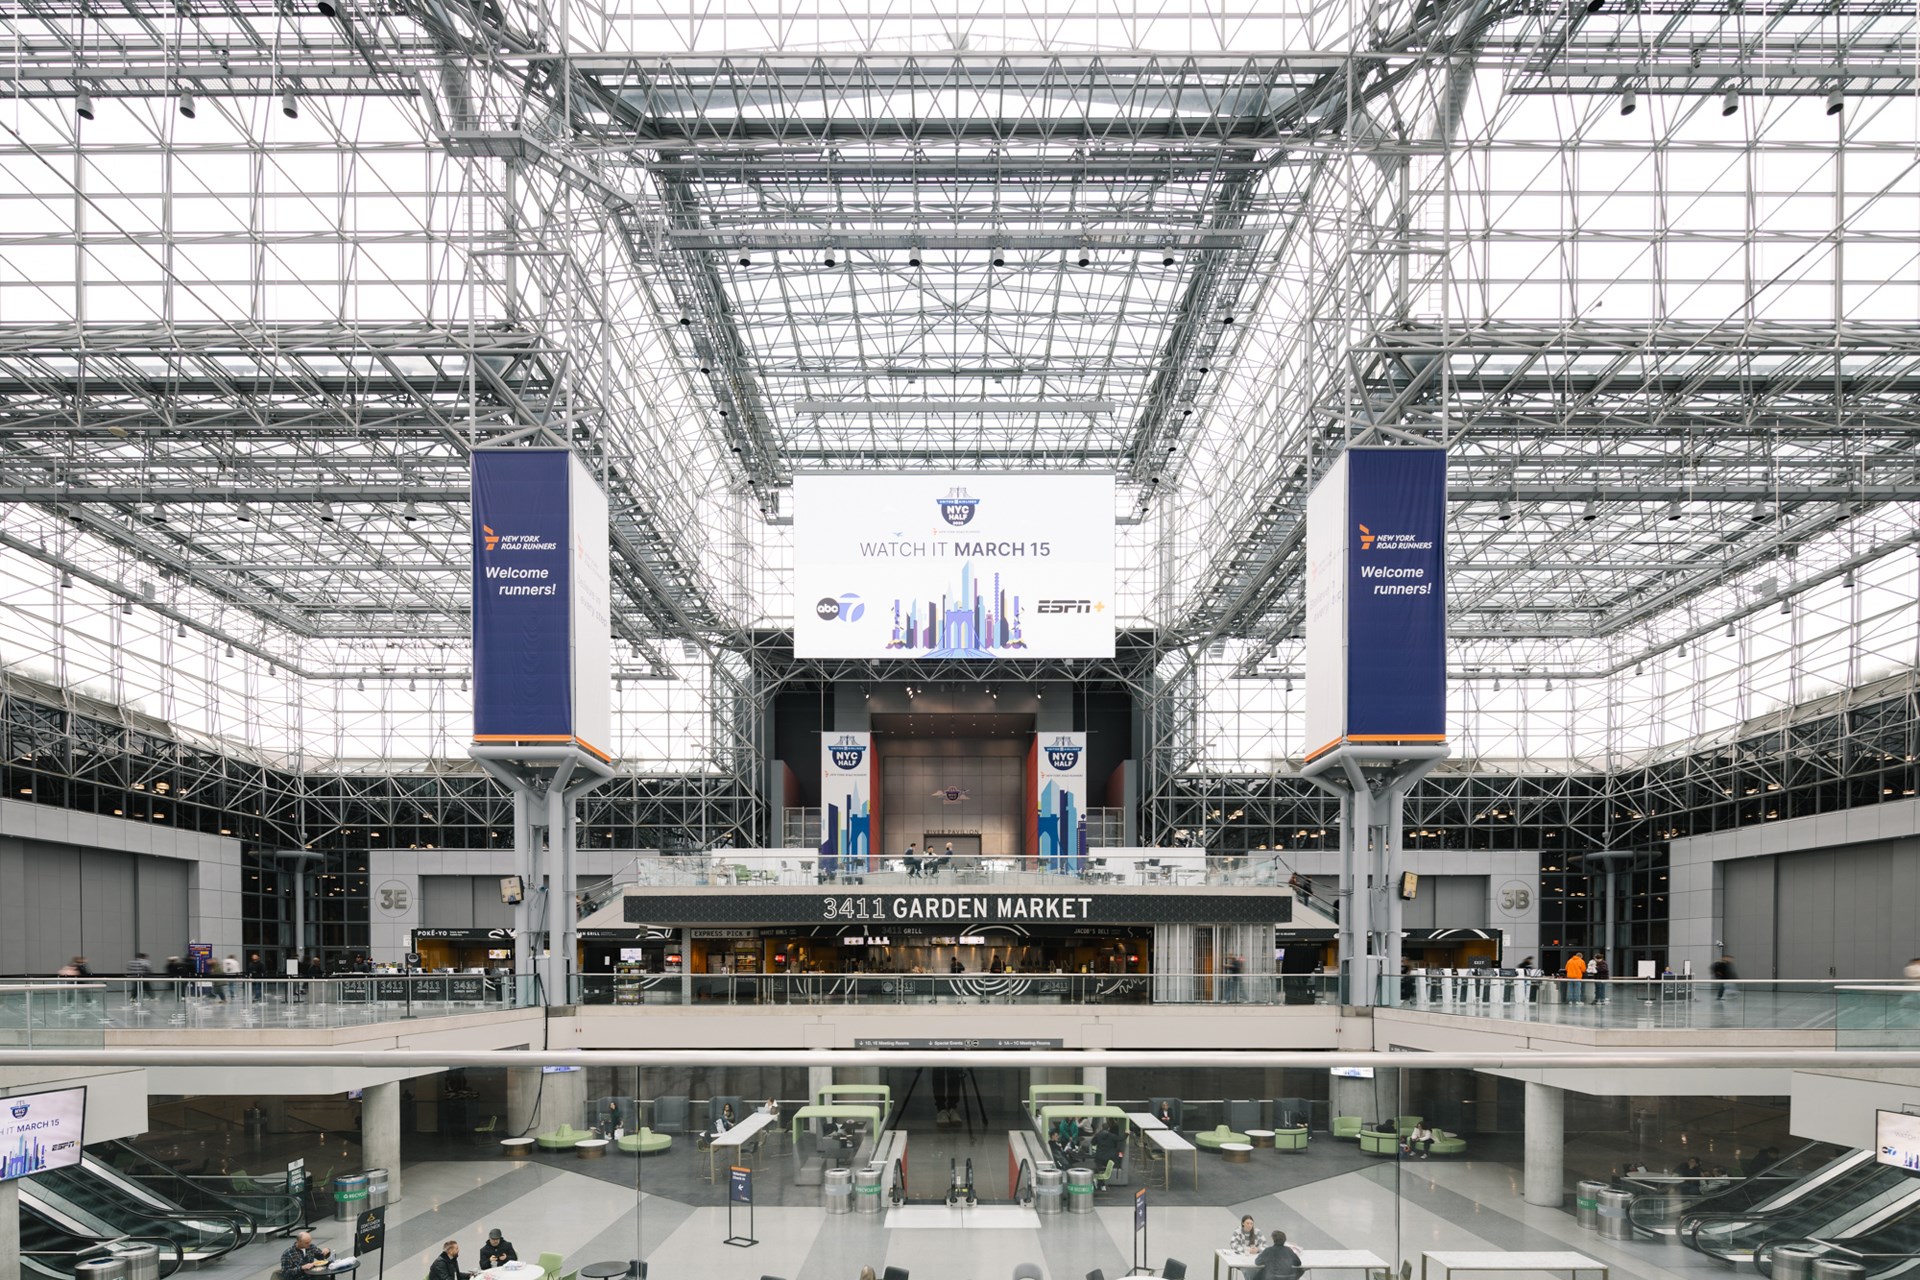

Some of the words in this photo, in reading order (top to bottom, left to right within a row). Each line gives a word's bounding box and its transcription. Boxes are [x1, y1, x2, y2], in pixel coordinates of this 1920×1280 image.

[947, 506, 970, 514] NYC
[860, 542, 926, 556] WATCH
[932, 542, 948, 556] IT
[955, 542, 1024, 556] MARCH
[1030, 542, 1050, 556] 15
[485, 566, 549, 578] Welcome
[1361, 566, 1424, 578] Welcome
[498, 584, 556, 596] runners!
[1374, 583, 1432, 594] runners!
[818, 604, 838, 613] abc
[836, 752, 858, 760] NYC
[381, 889, 407, 909] 3E
[1501, 889, 1530, 909] 3B
[824, 898, 885, 919] 3411
[893, 898, 988, 918] GARDEN
[997, 898, 1092, 918] MARKET
[380, 981, 403, 990] 3411
[417, 981, 440, 990] 3411
[17, 1121, 48, 1133] MARCH
